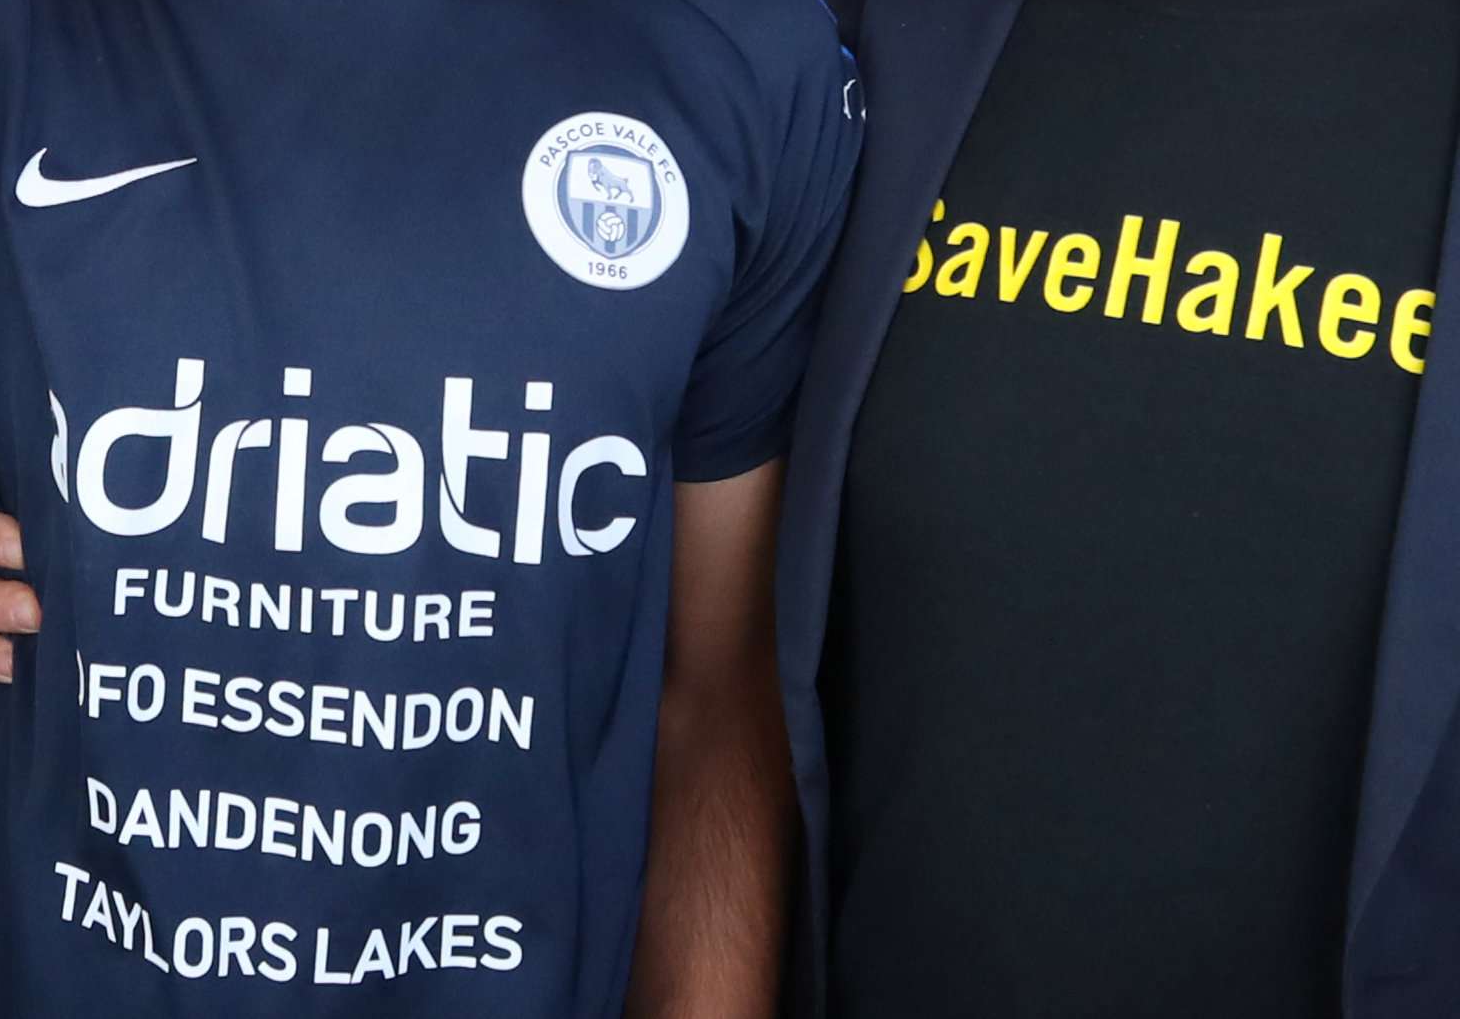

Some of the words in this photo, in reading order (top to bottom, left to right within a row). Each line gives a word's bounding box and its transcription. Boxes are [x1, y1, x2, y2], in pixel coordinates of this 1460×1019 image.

[540, 122, 605, 167] PASCOE
[613, 124, 658, 157] VALE
[658, 158, 676, 184] FC
[588, 262, 628, 279] 1966
[49, 358, 647, 565] driatic
[113, 568, 496, 643] FURNITURE
[76, 650, 166, 723] FO
[182, 667, 534, 751] ESSENDON
[87, 777, 481, 868] DANDENONG
[54, 862, 298, 982] TAYLORS
[314, 914, 523, 985] LAKES
